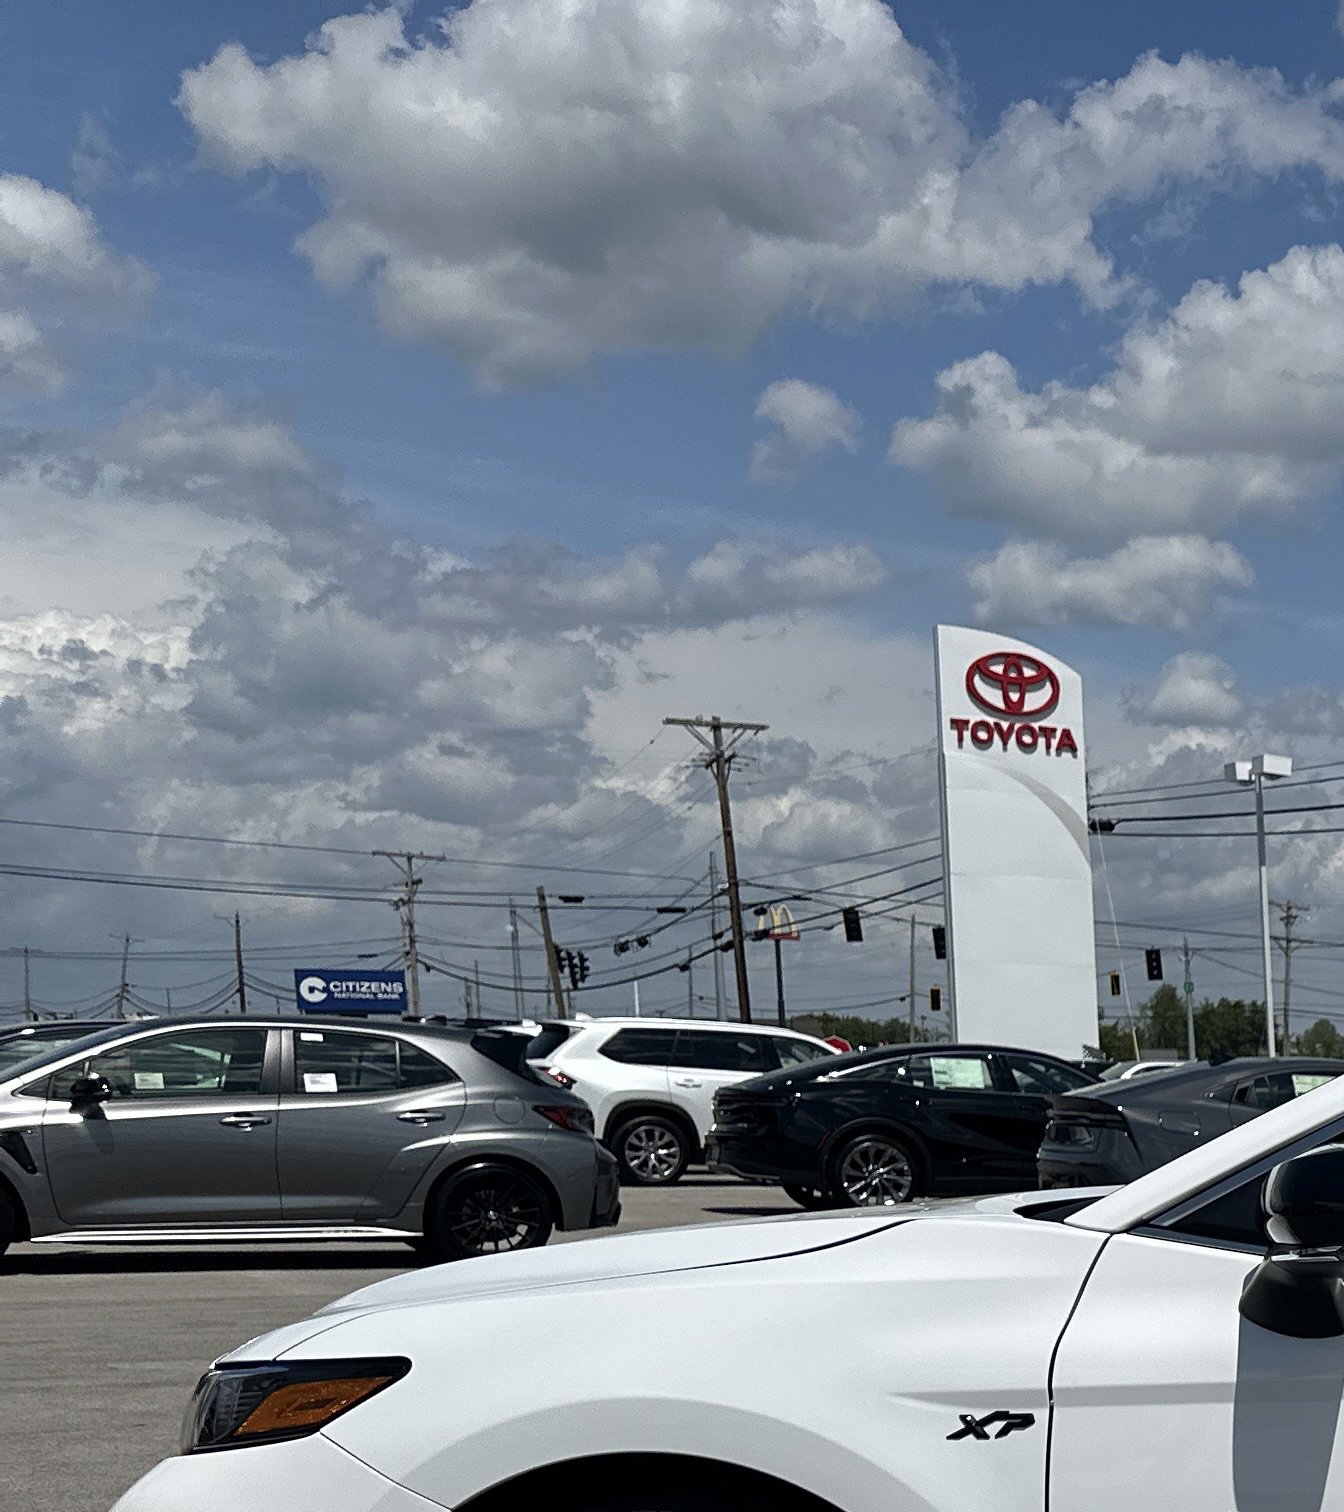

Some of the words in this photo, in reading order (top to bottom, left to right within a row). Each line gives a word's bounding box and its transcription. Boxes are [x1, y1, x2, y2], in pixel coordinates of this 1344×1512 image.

[950, 717, 1078, 758] TOYOTA
[329, 980, 404, 993] CITIZENS
[945, 1410, 1036, 1440] XP
